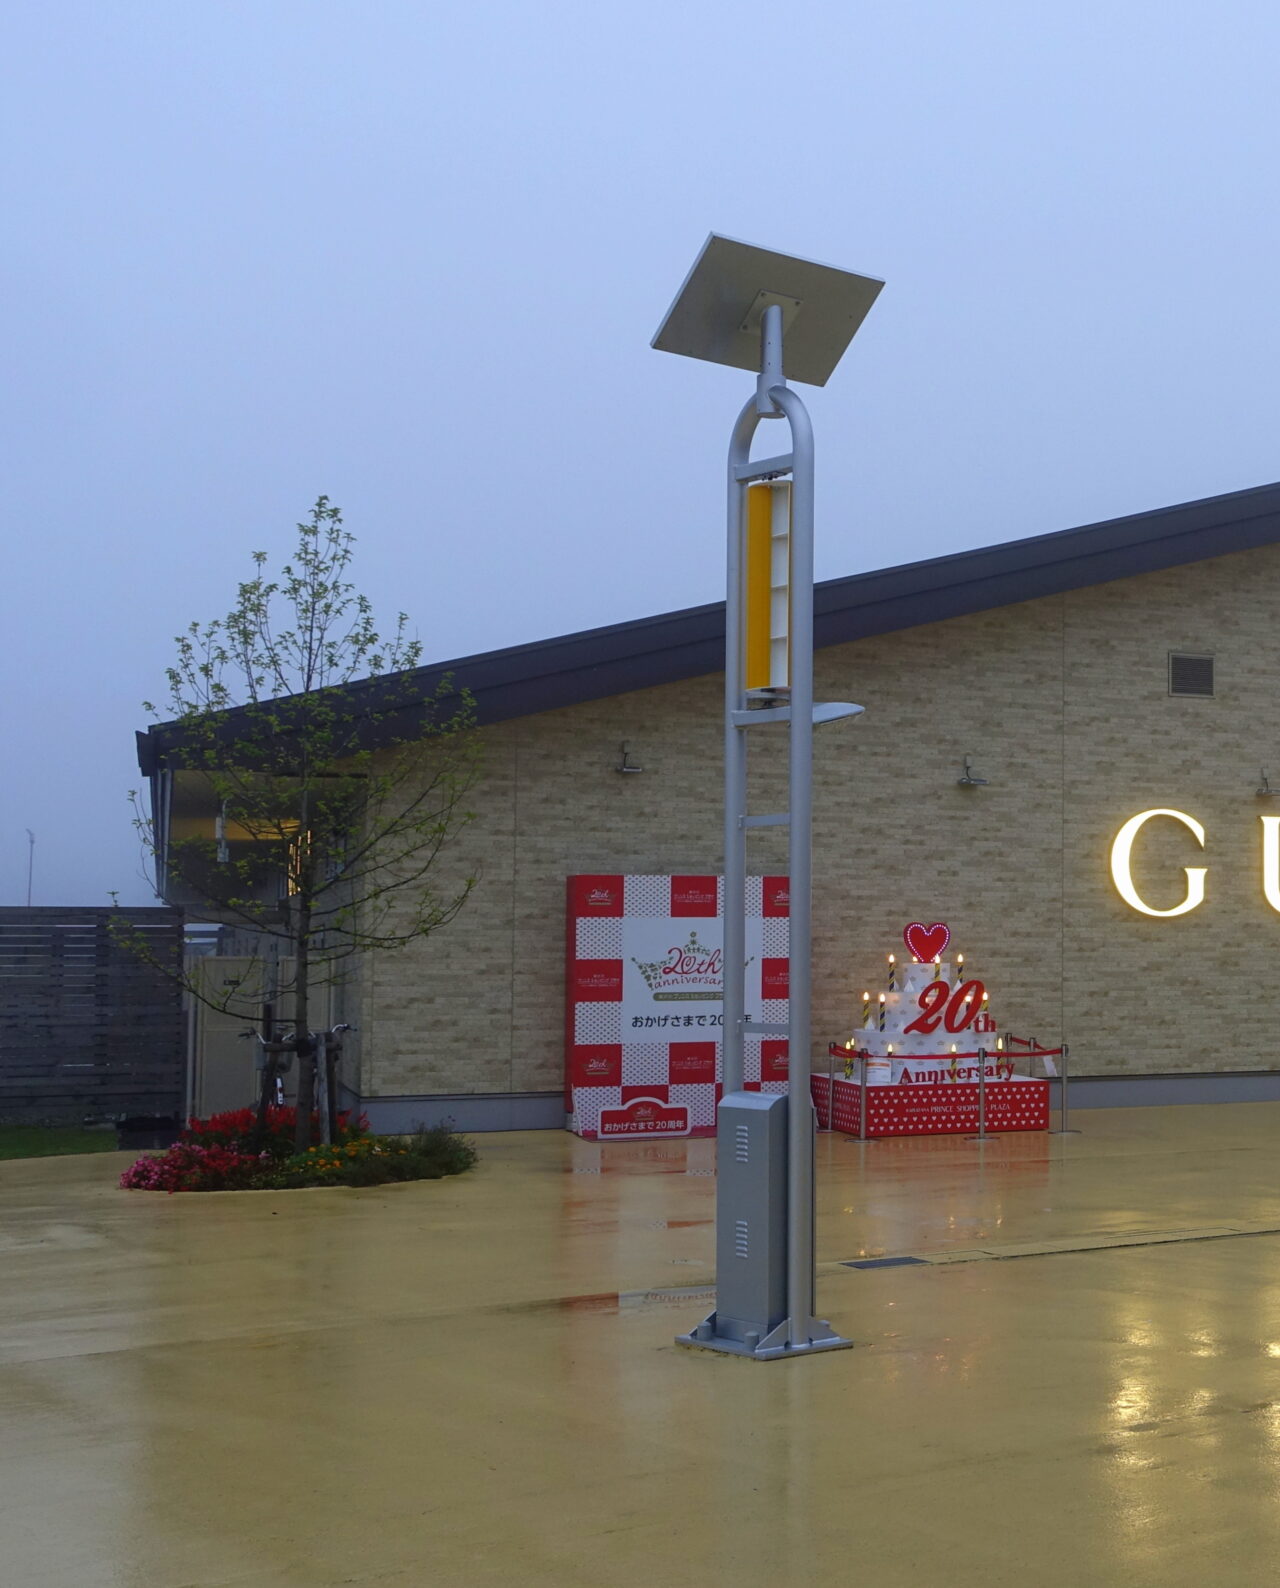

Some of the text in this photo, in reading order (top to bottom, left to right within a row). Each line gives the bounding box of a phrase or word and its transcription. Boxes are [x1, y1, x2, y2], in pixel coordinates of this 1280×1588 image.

[662, 947, 723, 974] 20th
[654, 975, 723, 989] anniversar
[903, 980, 997, 1034] 20th
[931, 1105, 953, 1113] PRINCE
[956, 1104, 988, 1112] SHOPPI
